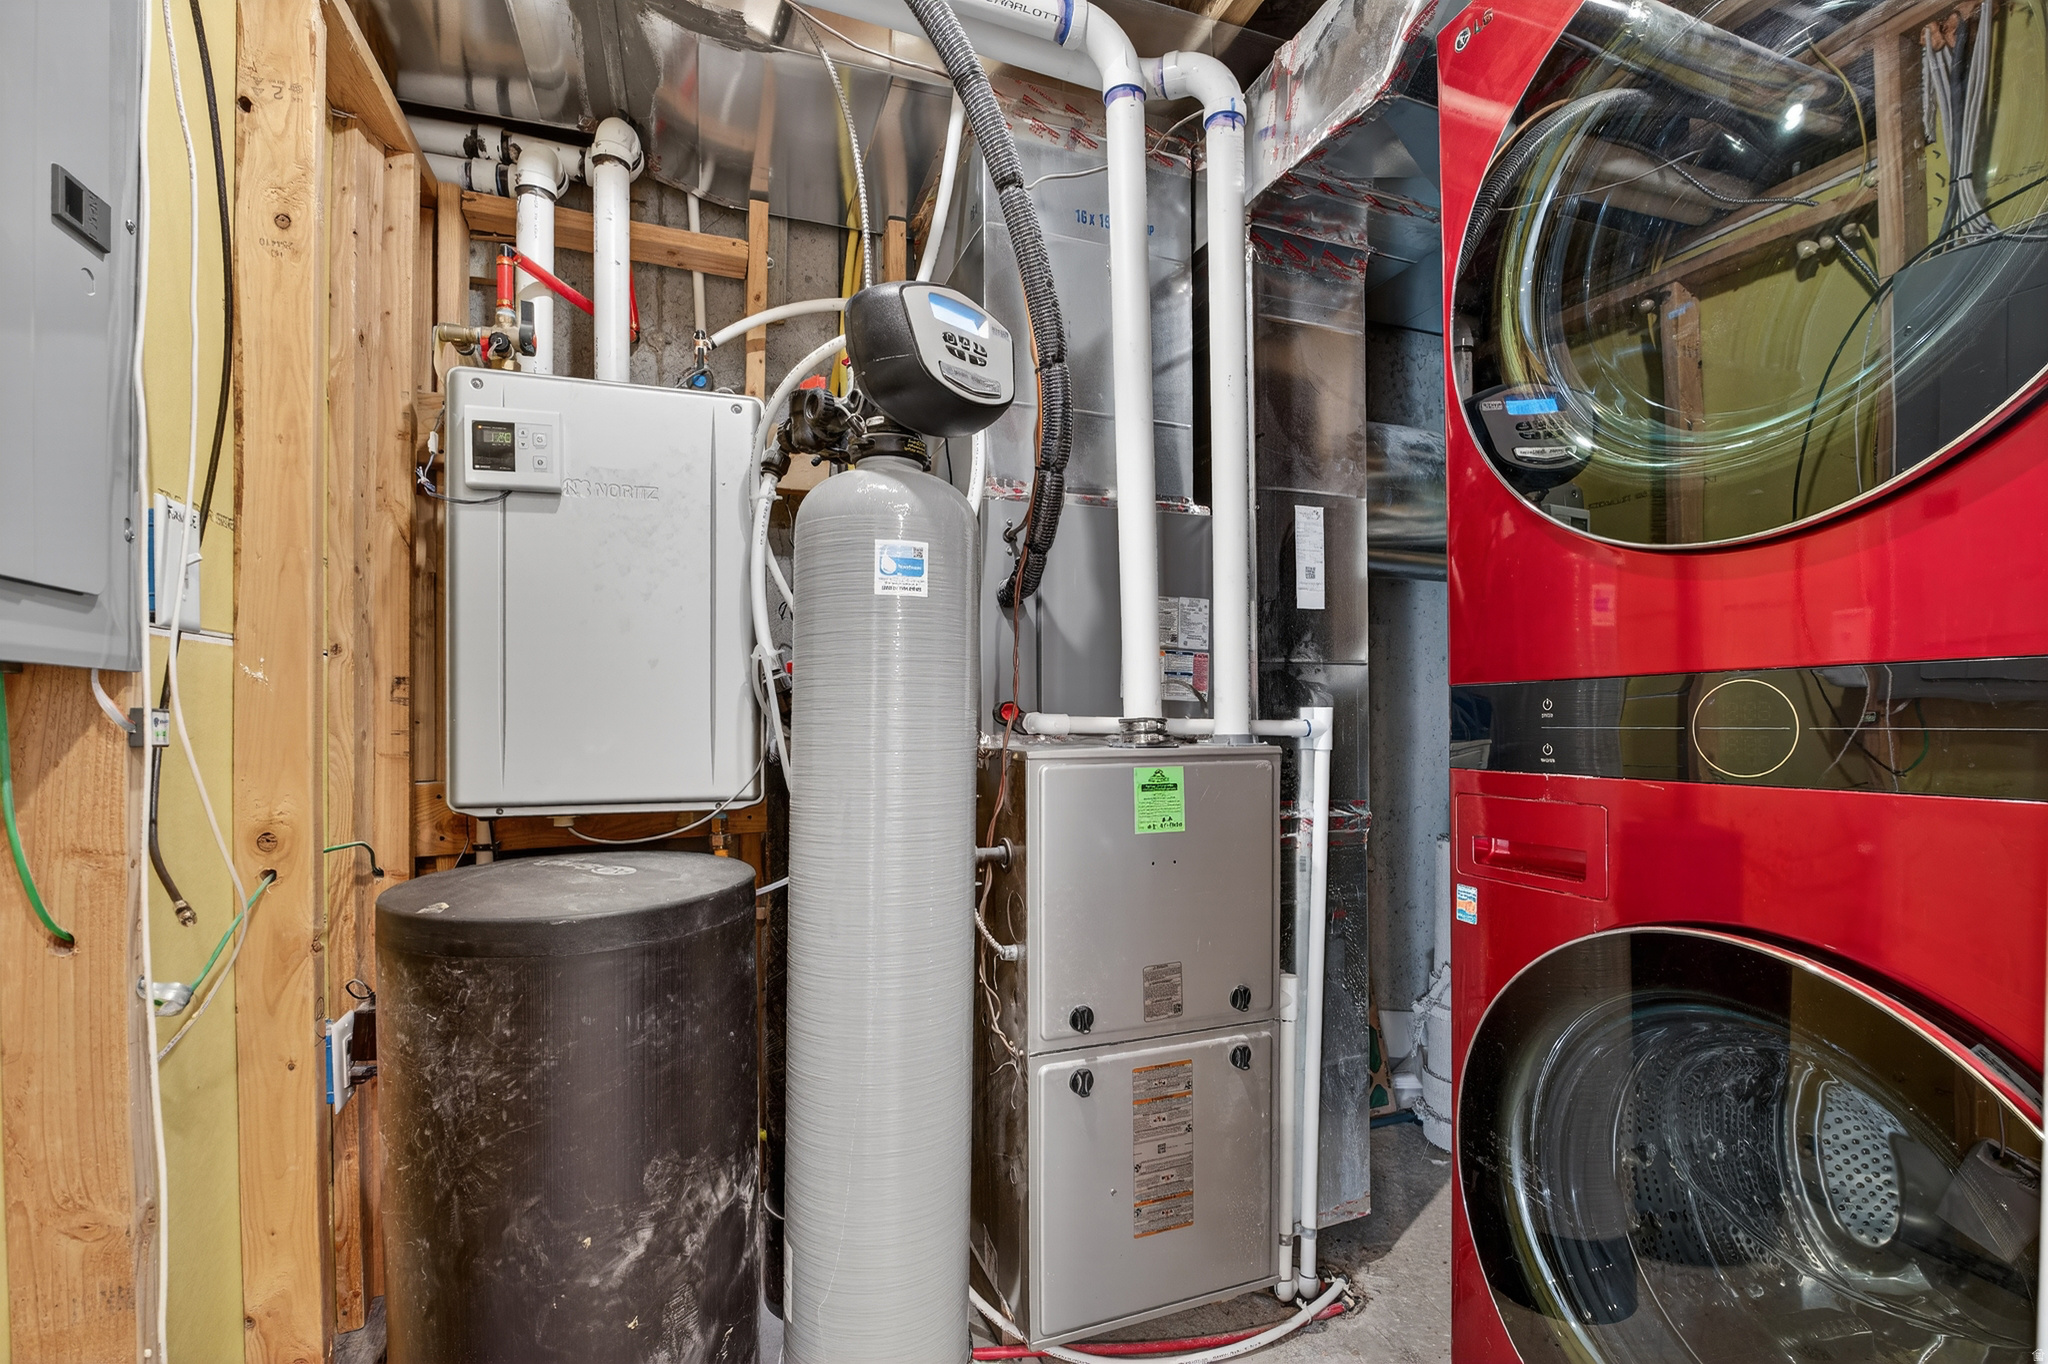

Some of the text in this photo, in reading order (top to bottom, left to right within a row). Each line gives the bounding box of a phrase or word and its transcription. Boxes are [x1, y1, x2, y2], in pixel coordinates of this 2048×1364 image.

[1474, 8, 1494, 34] LG
[1075, 208, 1088, 224] 16
[594, 481, 660, 501] NORITZ
